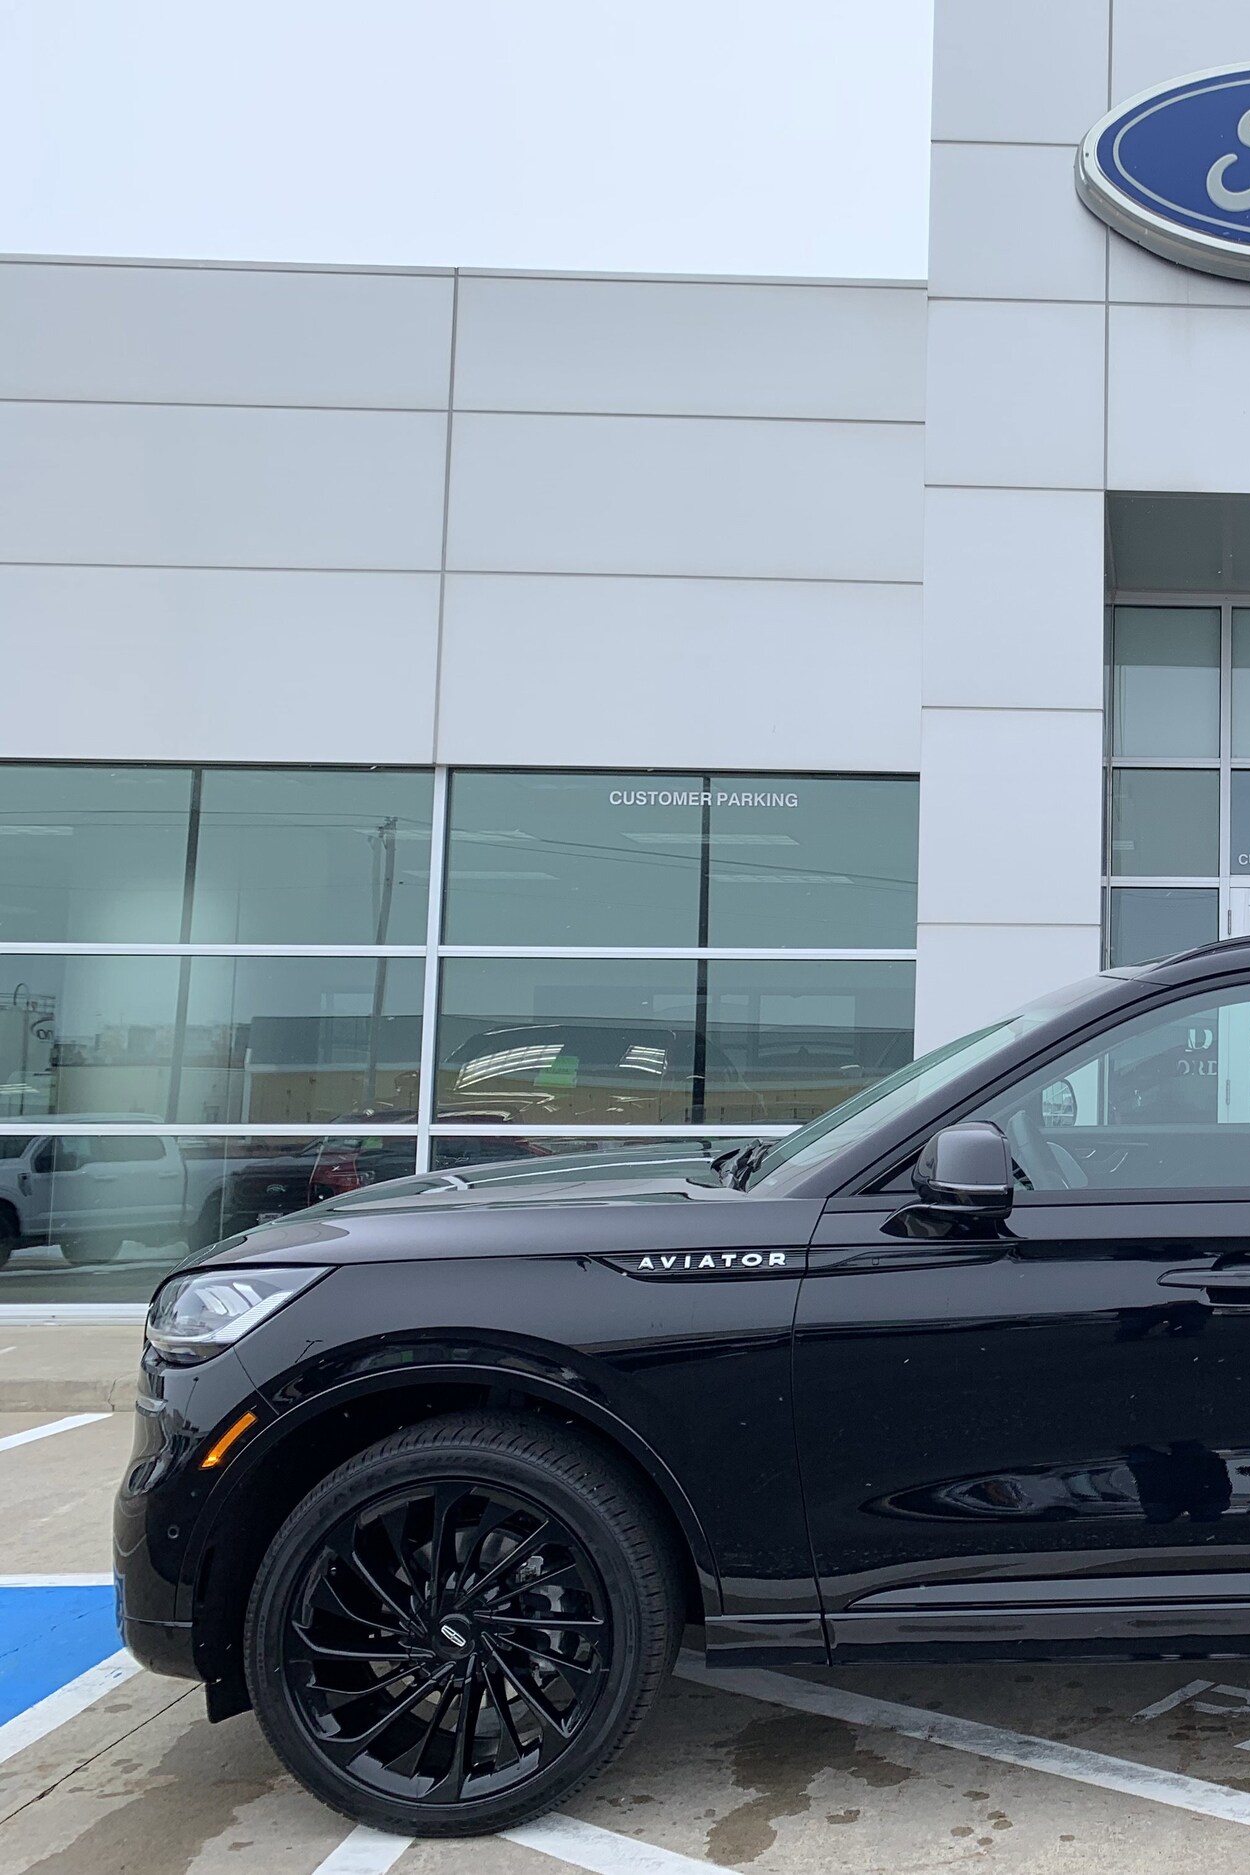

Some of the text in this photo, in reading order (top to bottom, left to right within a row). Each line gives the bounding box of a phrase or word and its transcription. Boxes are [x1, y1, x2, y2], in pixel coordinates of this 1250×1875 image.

[609, 790, 798, 807] CUSTOMER PARKING
[637, 1252, 786, 1270] AVIATOR
